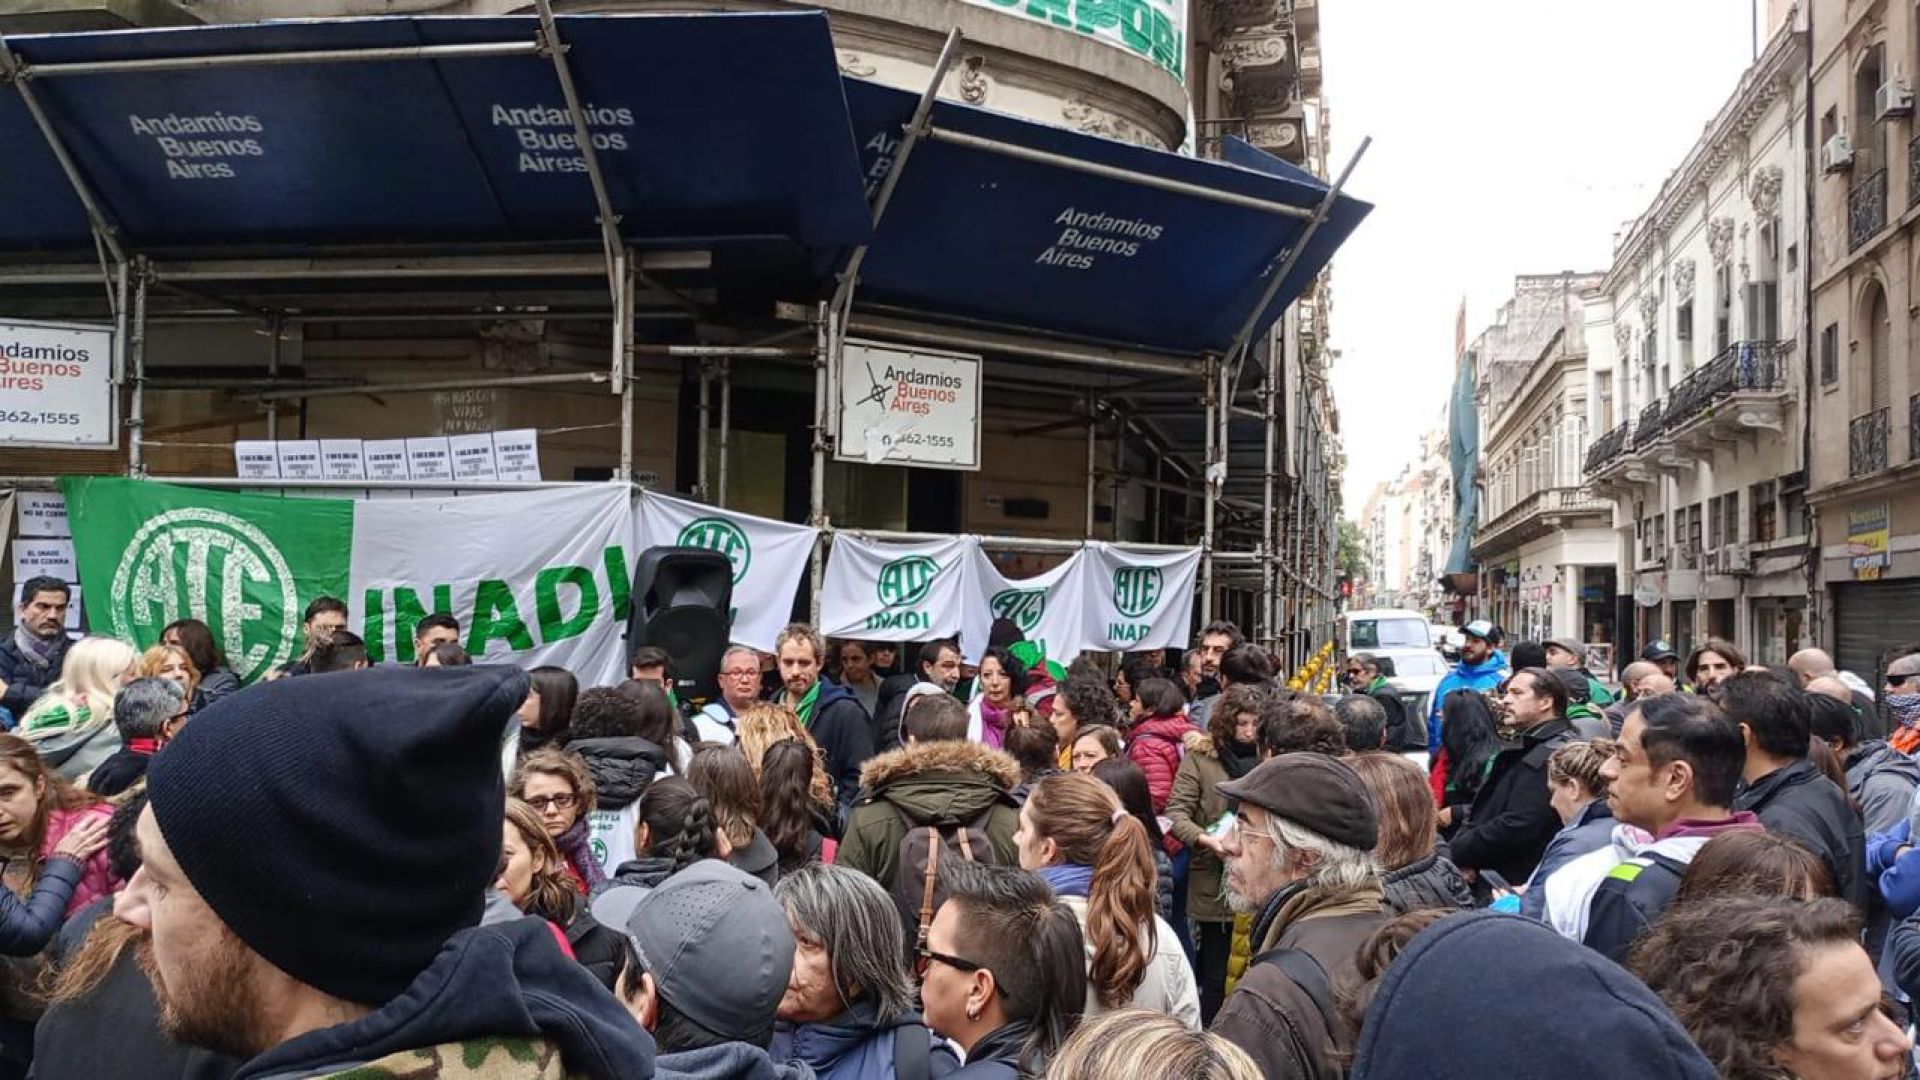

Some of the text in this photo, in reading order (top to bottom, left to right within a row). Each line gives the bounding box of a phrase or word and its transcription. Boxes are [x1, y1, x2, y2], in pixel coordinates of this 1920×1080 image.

[128, 111, 264, 135] Andamios
[156, 136, 264, 157] Buenos
[166, 159, 236, 179] Aires
[519, 152, 590, 172] Aires
[1055, 207, 1163, 240] Andamios
[1057, 228, 1140, 256] Buenos
[1035, 246, 1094, 269] Aires
[0, 376, 43, 391] ires
[884, 365, 962, 389] Andamios
[897, 381, 956, 403] Buenos
[890, 396, 931, 415] Aires
[1117, 569, 1158, 613] ATE
[132, 528, 271, 680] ATE
[363, 545, 632, 662] INADI
